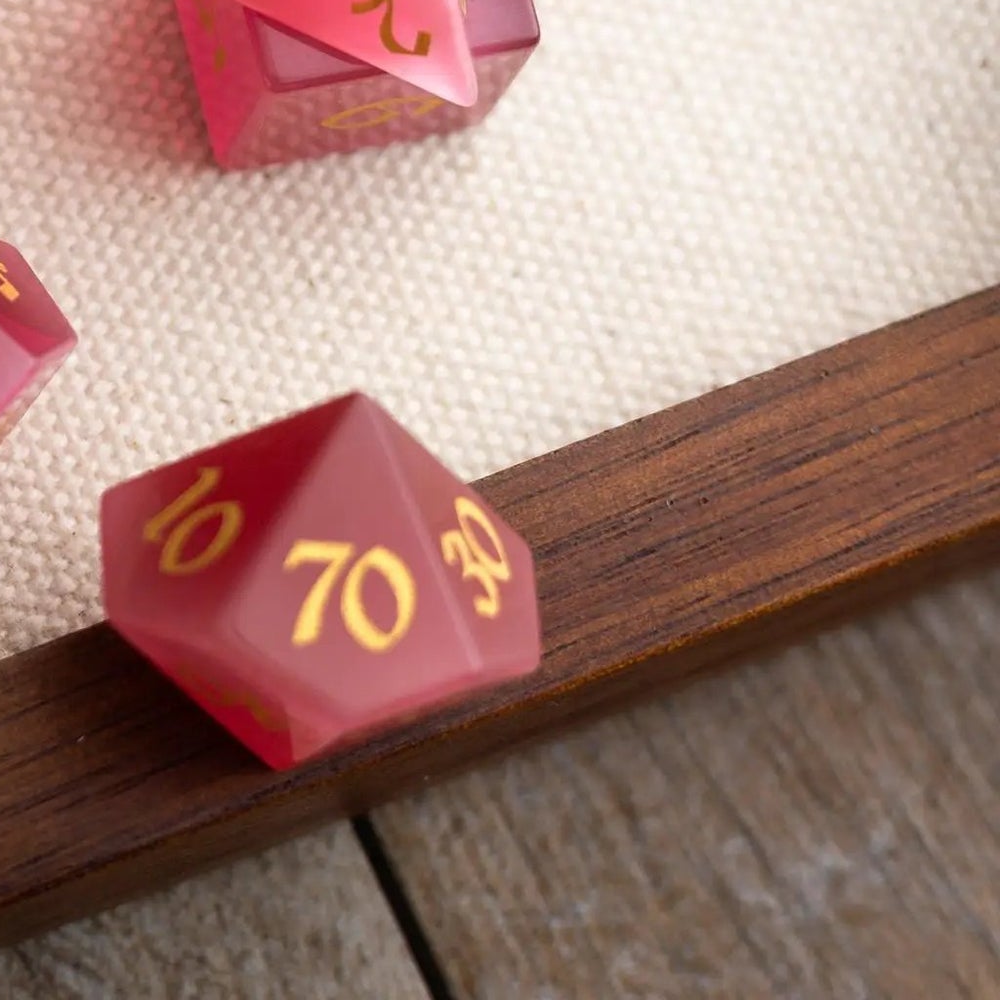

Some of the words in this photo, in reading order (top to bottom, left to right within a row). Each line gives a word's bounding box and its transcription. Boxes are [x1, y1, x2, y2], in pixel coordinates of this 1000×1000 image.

[143, 466, 244, 576] 10
[440, 497, 512, 620] 30
[283, 537, 418, 656] 70
